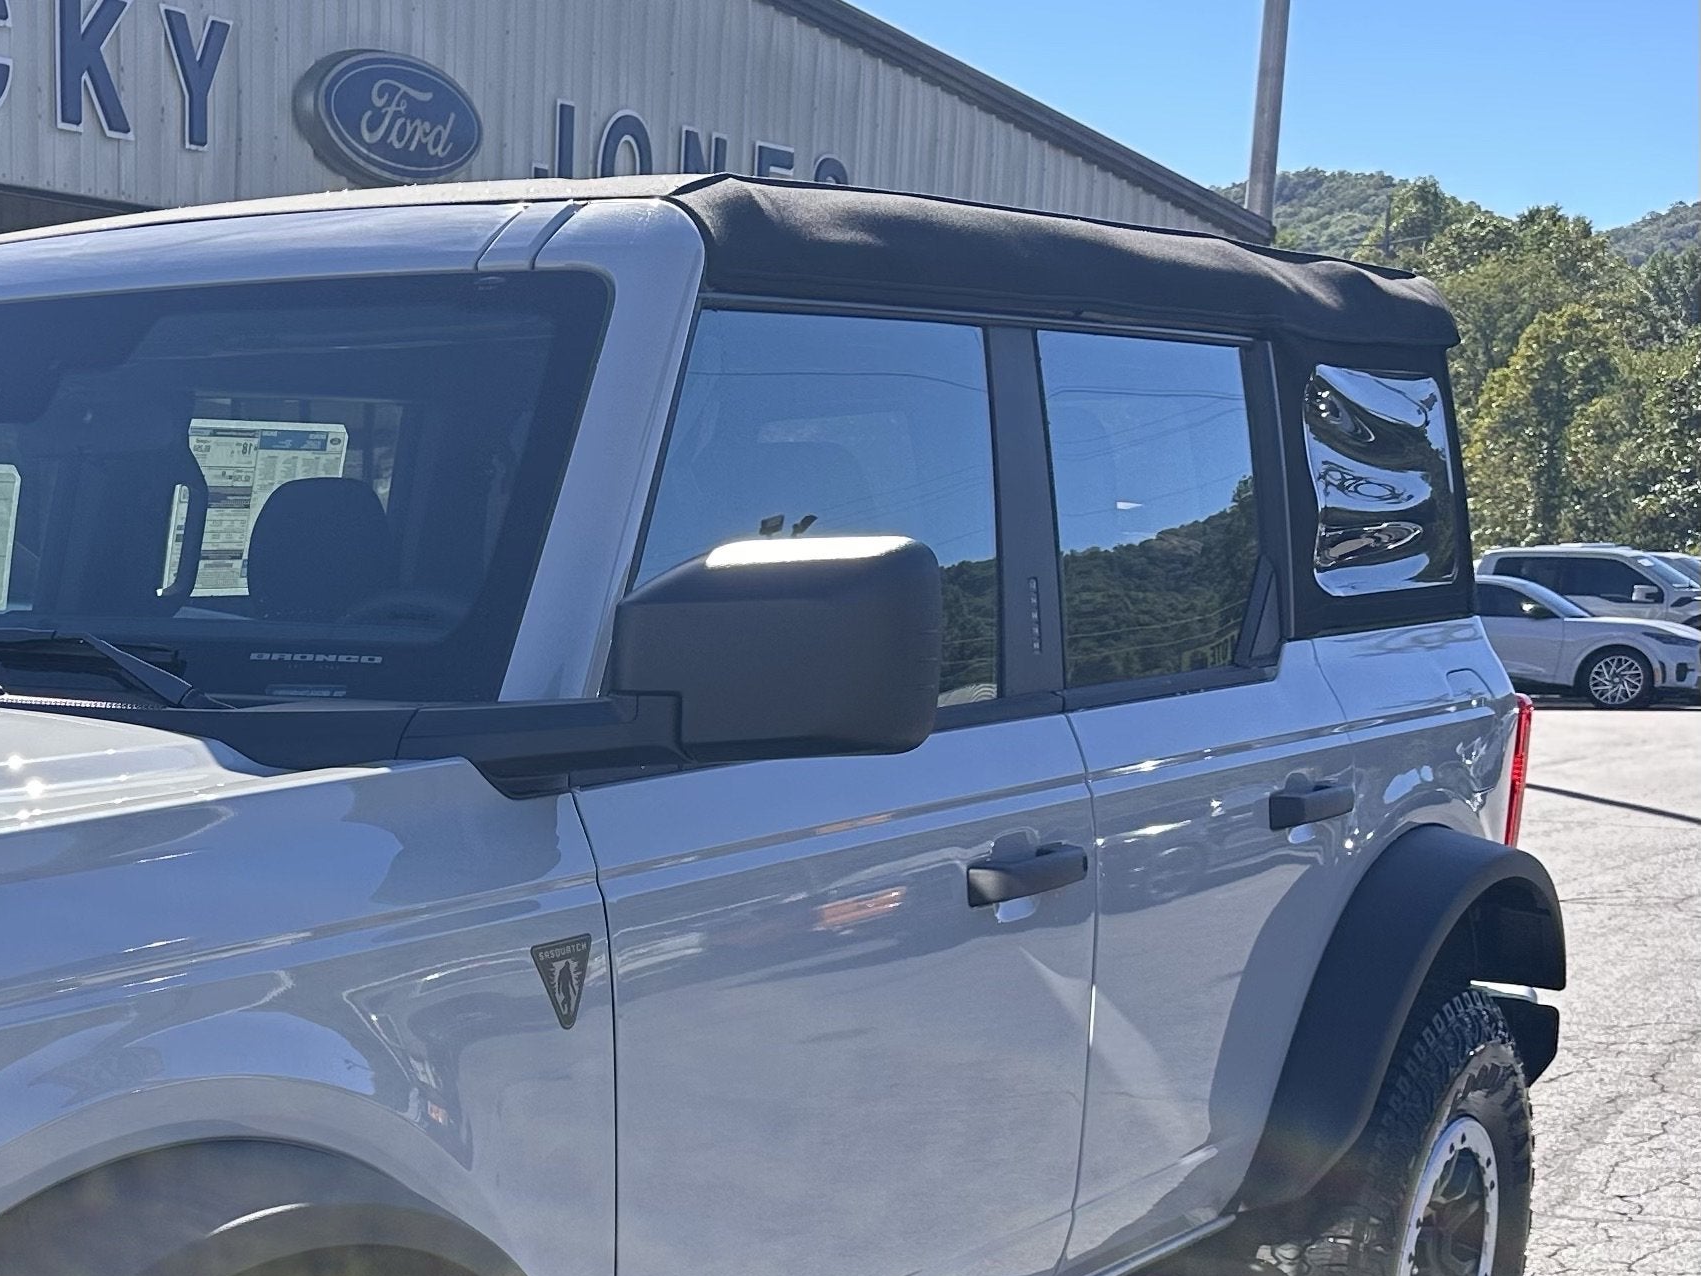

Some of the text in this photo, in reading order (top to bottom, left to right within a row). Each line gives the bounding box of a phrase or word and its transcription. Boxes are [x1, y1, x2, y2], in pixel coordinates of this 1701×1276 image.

[360, 79, 456, 158] Ford
[249, 652, 383, 664] BRONCO
[539, 942, 587, 961] SASQUATCH
